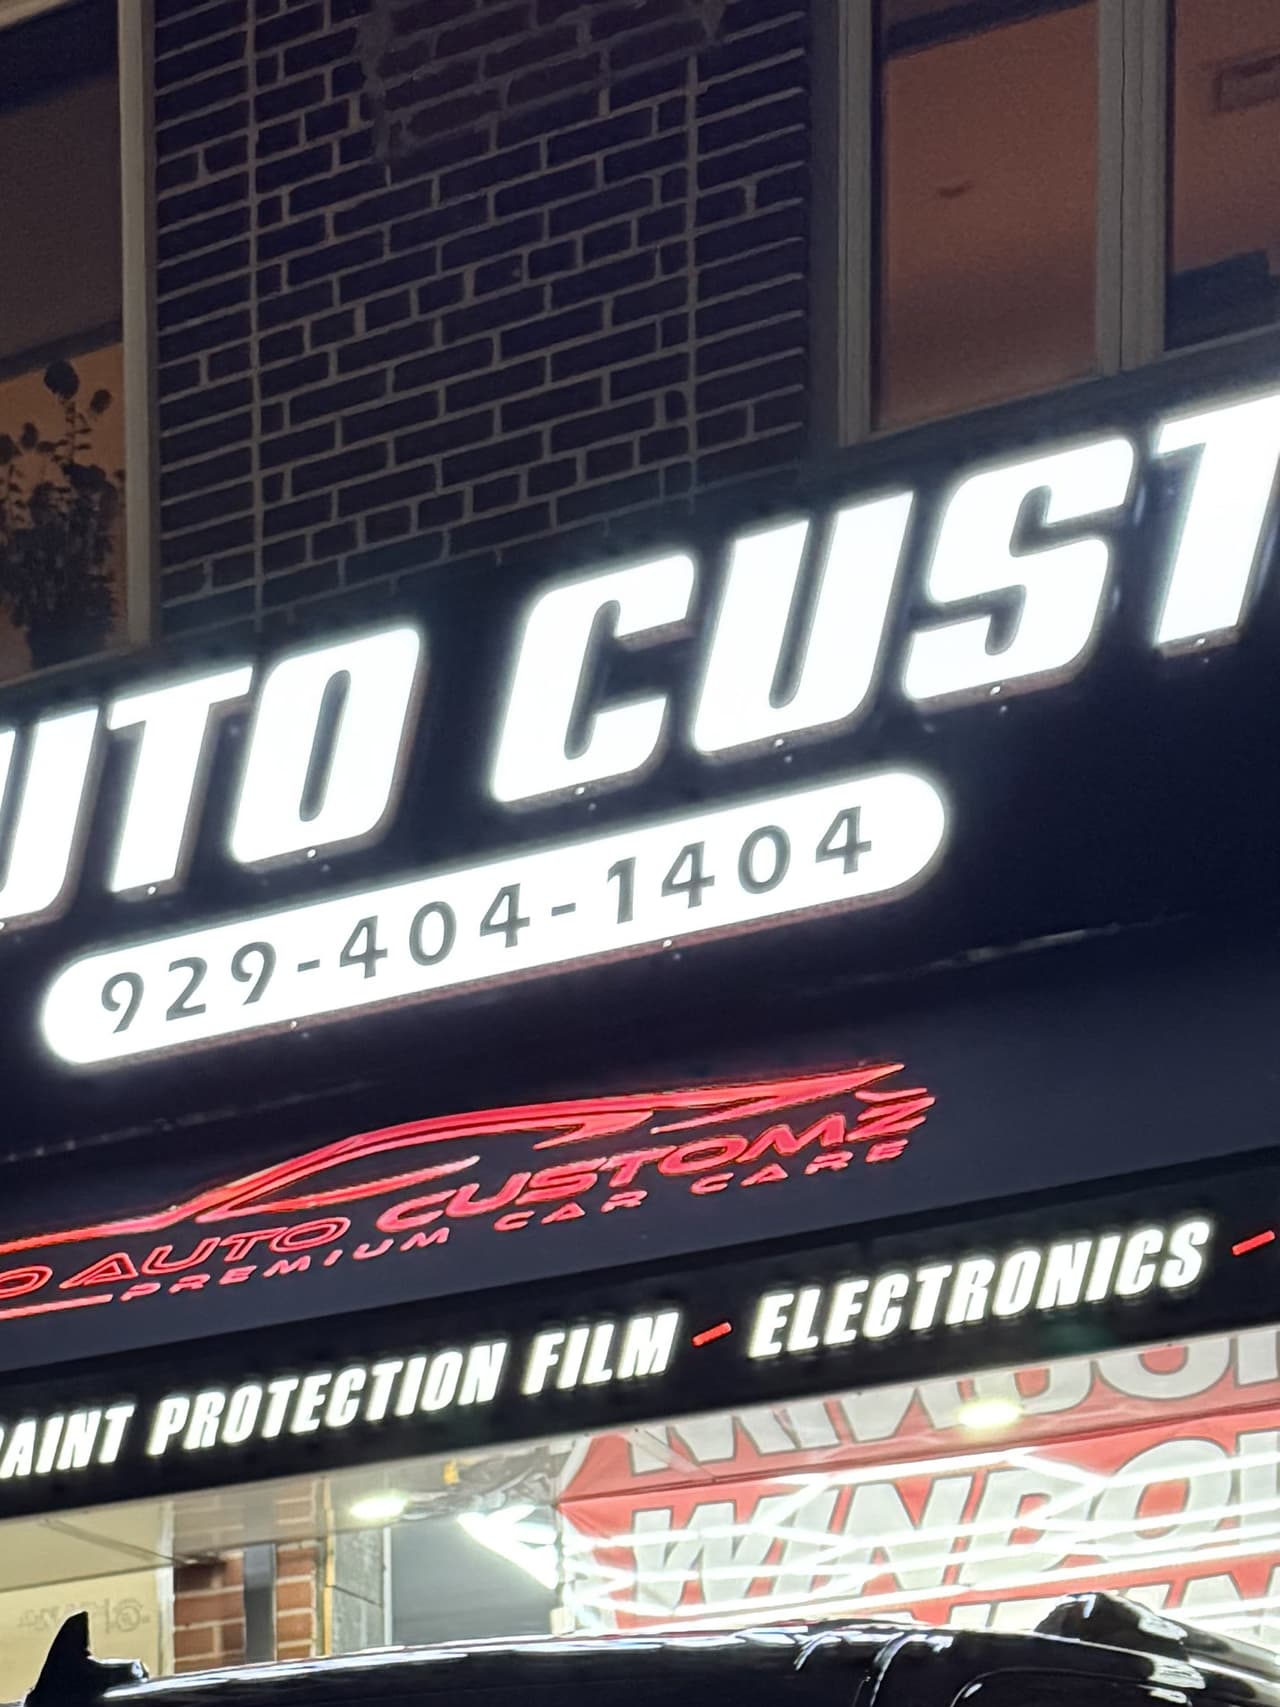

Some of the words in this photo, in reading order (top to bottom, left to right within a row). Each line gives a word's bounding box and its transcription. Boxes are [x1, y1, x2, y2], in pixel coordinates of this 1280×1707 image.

[99, 804, 873, 1036] 929-404-1404
[59, 1215, 352, 1291] AUTO
[376, 1086, 936, 1234] CUSTOMZ
[120, 1227, 450, 1302] PREMIUM
[492, 1188, 648, 1231] CAR
[690, 1138, 909, 1196] CARE
[148, 1340, 512, 1457] PROTECTION
[523, 1310, 682, 1397] FILM
[746, 1219, 1214, 1362] ELECTRONICS
